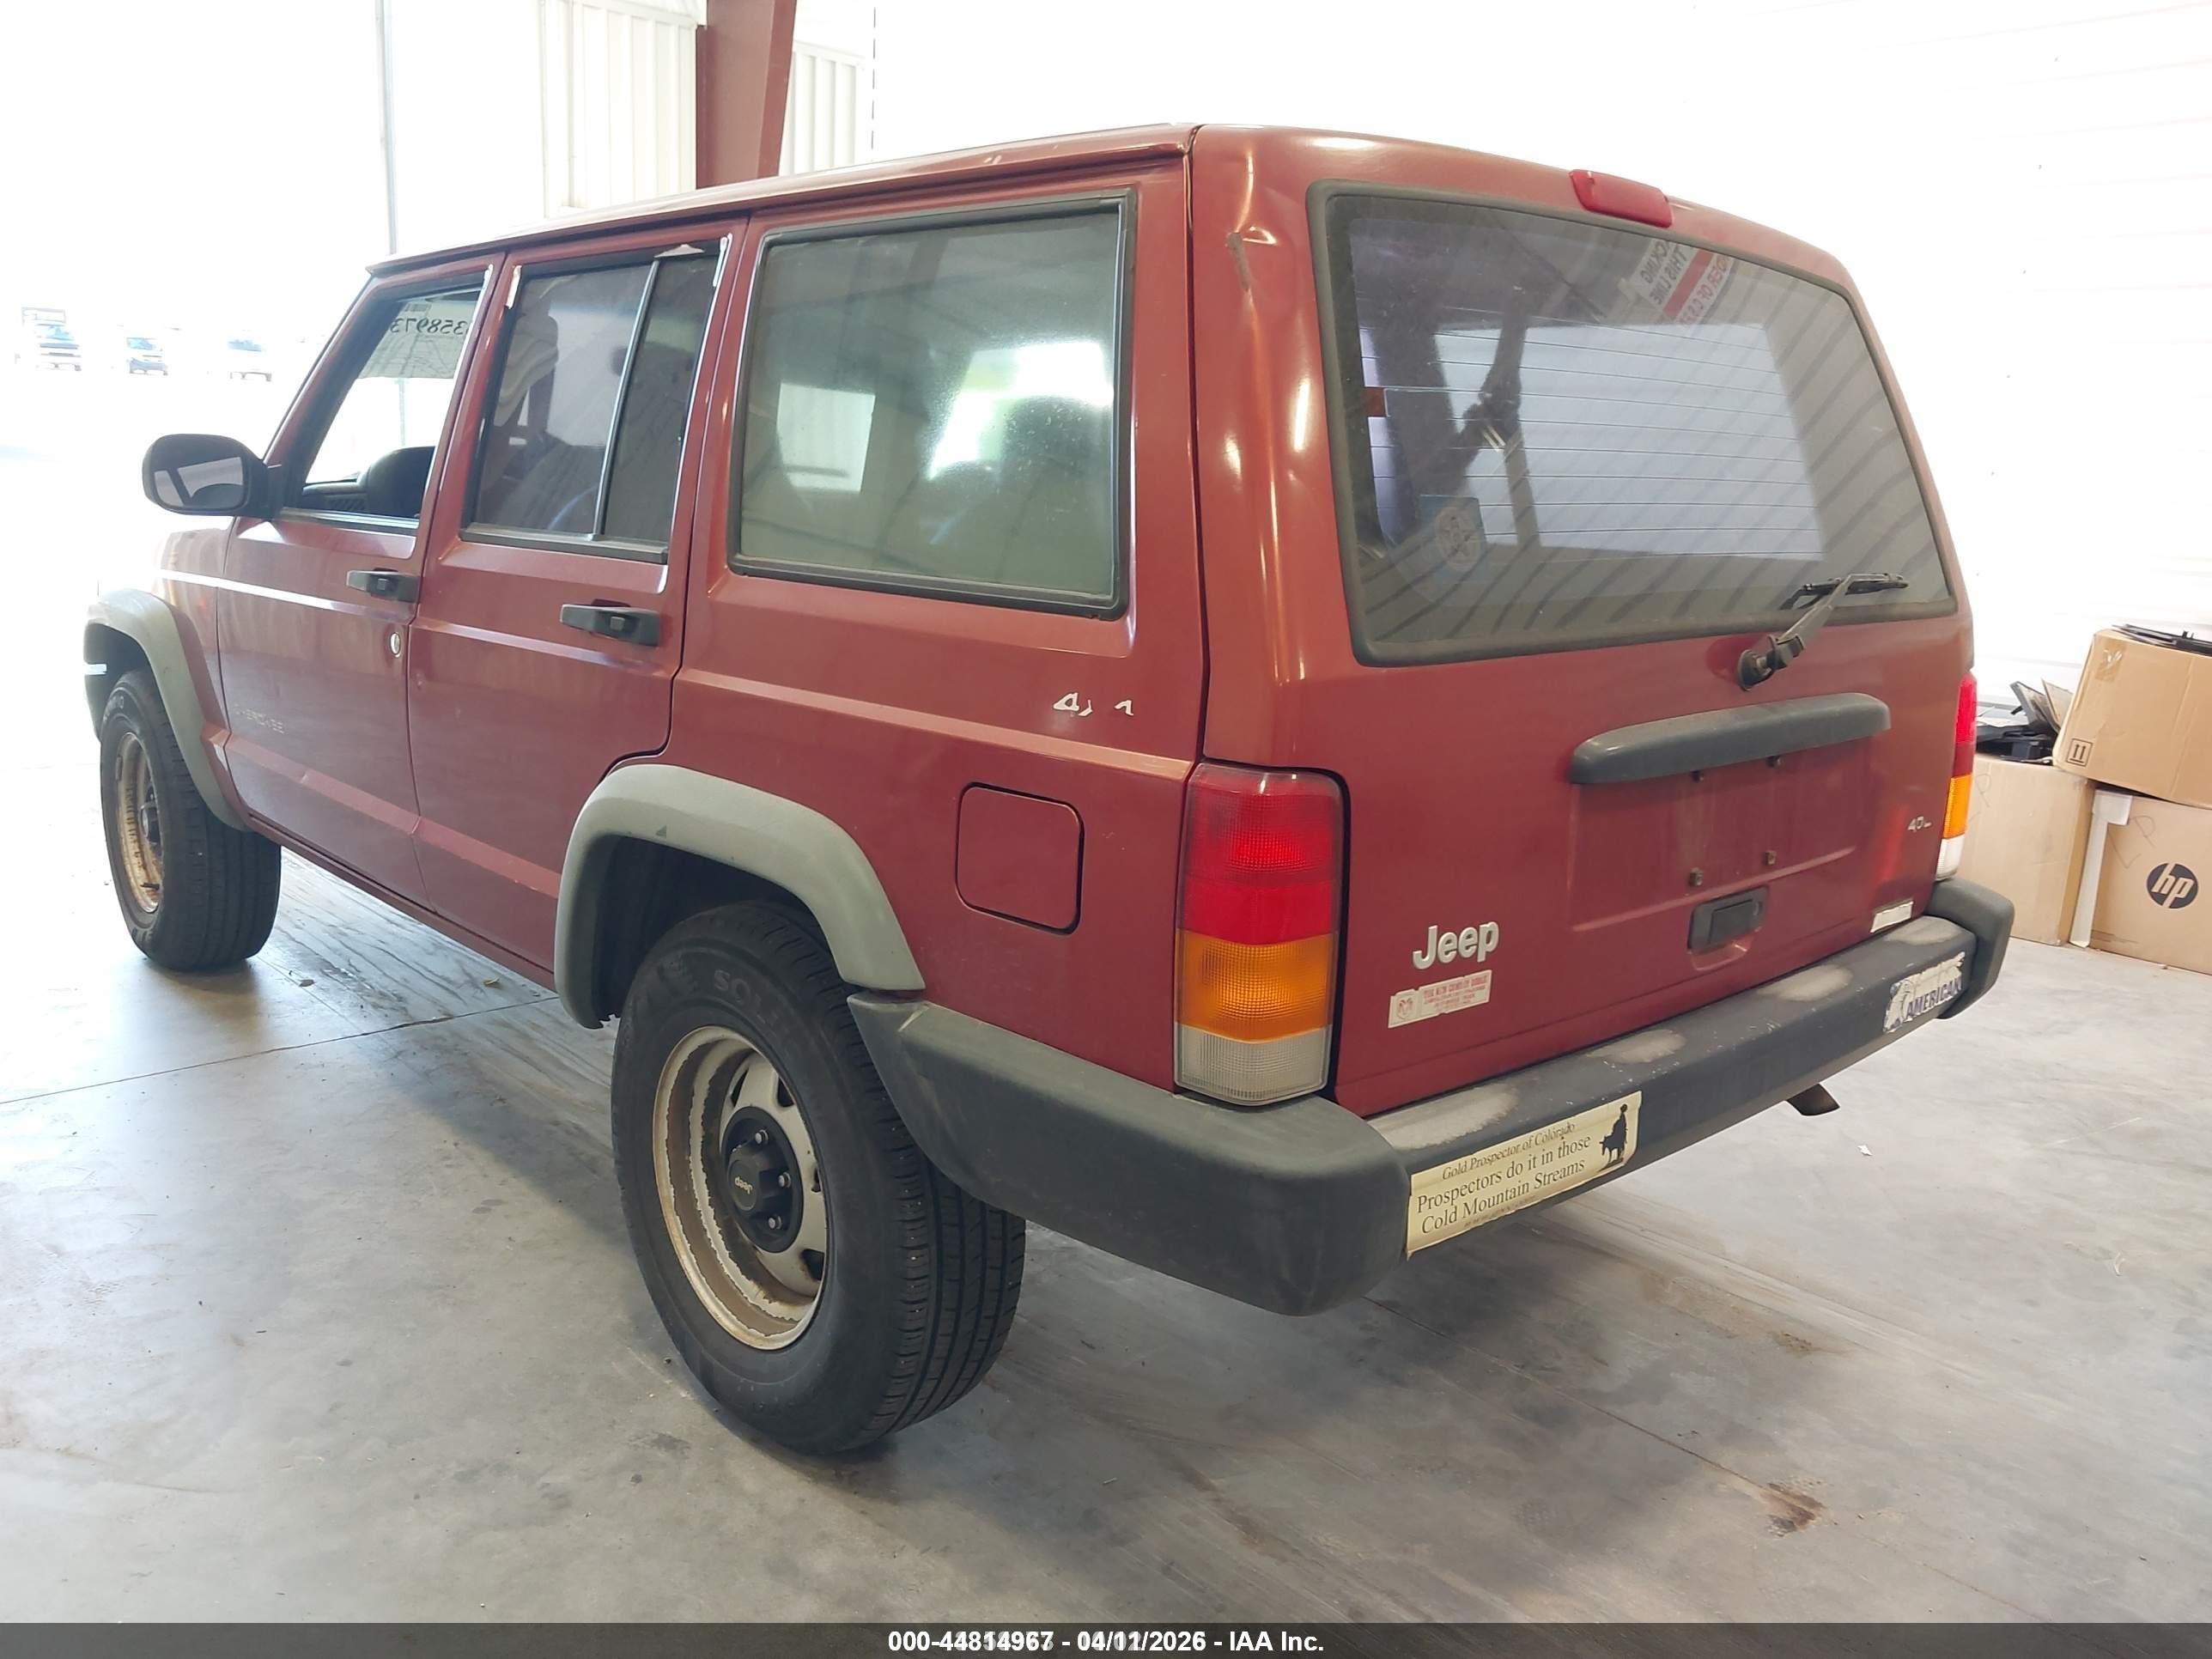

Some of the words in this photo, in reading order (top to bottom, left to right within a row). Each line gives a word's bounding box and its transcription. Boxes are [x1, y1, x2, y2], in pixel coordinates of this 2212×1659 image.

[2149, 862, 2196, 909] hp
[1413, 921, 1499, 969] Jeep
[1418, 1170, 1503, 1213] Prospectors
[1506, 1160, 1523, 1179] do
[1528, 1153, 1537, 1172] it
[1541, 1148, 1553, 1166] in
[1557, 1136, 1591, 1158] those
[1442, 1162, 1468, 1182] Gold
[1522, 1135, 1534, 1151] of
[1534, 1121, 1576, 1146] Colorado
[734, 1176, 753, 1194] Jeep
[1421, 1205, 1458, 1234] Cold
[1462, 1180, 1530, 1219] Mountain
[1534, 1159, 1585, 1190] Streams
